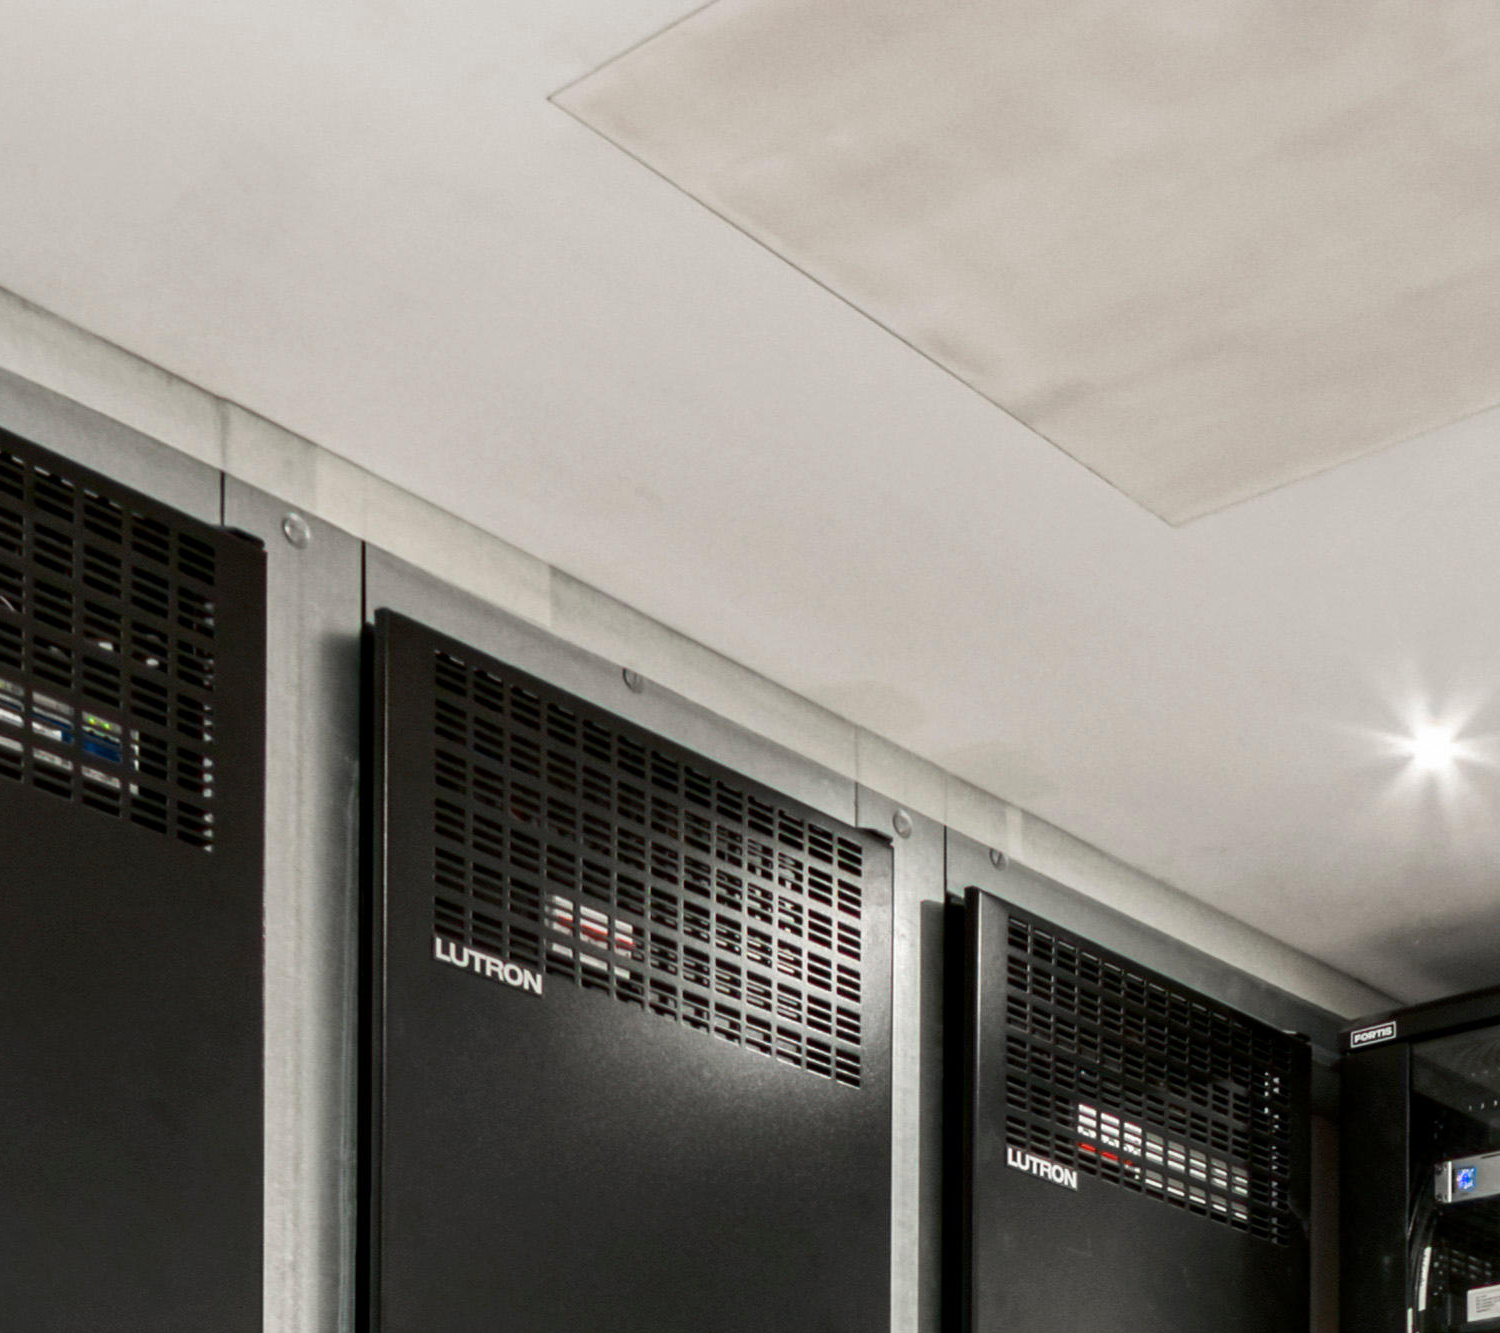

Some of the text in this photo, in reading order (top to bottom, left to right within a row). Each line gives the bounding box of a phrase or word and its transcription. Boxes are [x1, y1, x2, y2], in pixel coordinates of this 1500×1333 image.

[435, 936, 543, 995] LUTRON
[1354, 1026, 1392, 1043] FORTIS
[1007, 1147, 1078, 1189] LUTRON
